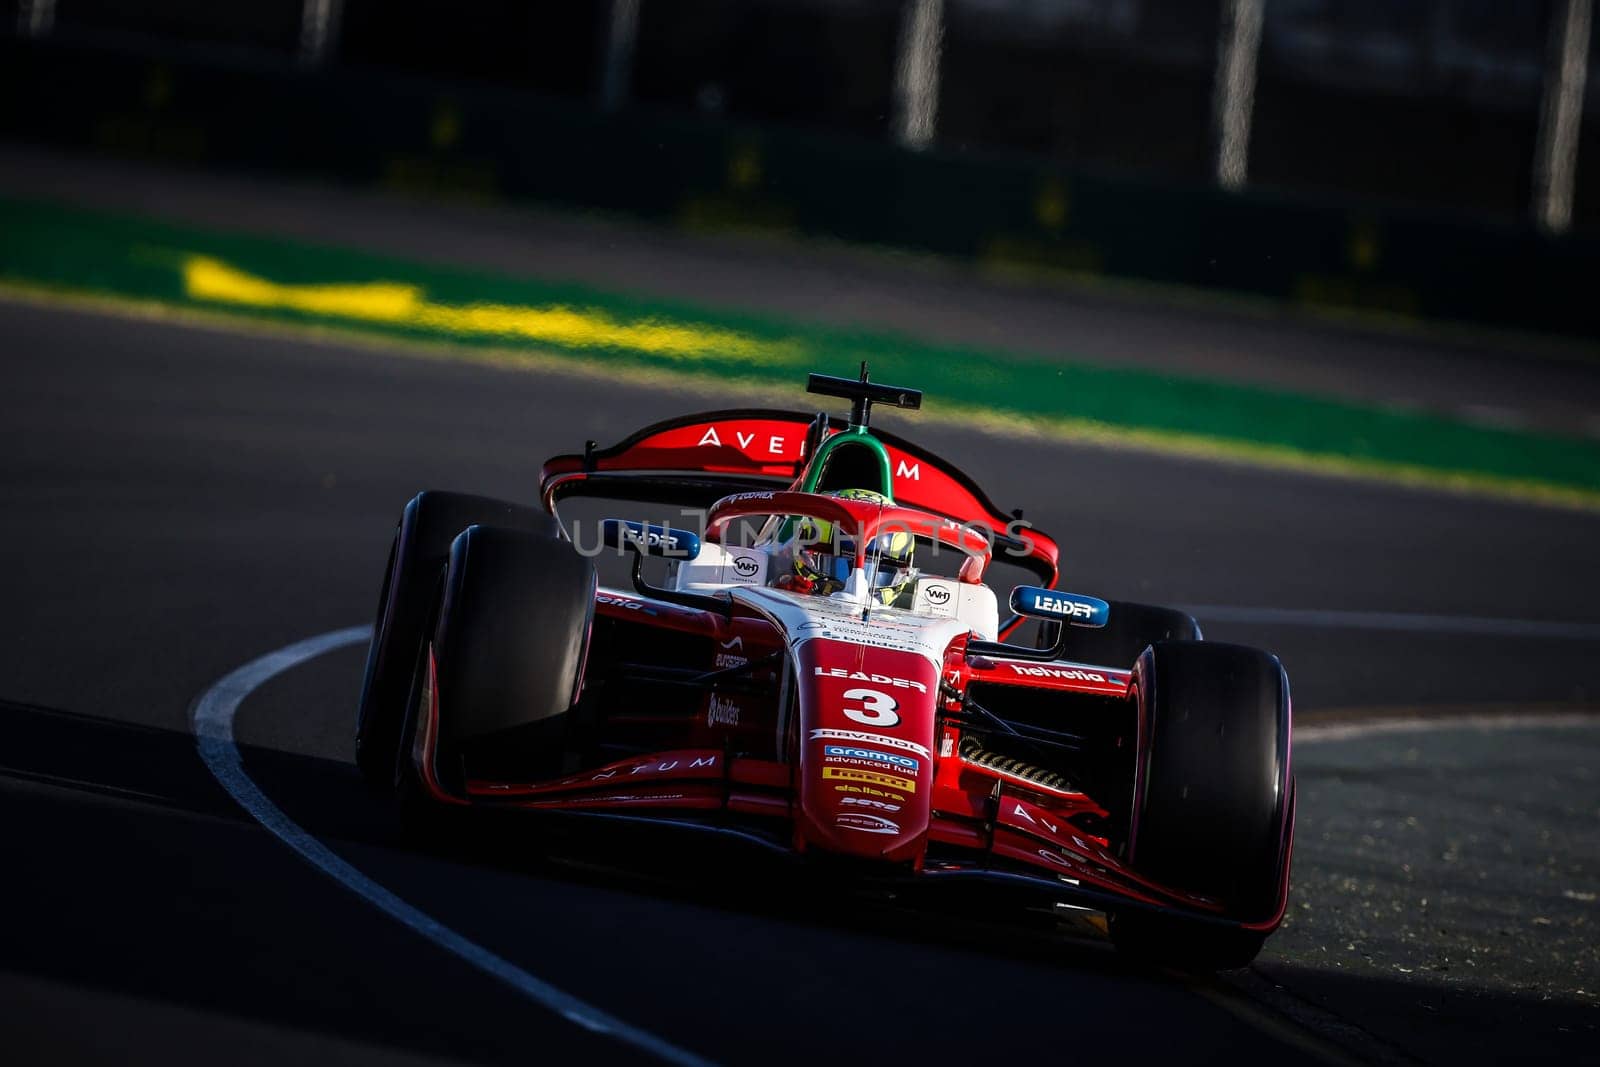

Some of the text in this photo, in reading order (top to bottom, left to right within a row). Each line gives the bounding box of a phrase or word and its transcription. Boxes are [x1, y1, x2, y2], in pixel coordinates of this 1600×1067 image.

[1034, 594, 1095, 619] LEADER
[814, 666, 926, 693] LEADER
[1010, 664, 1105, 683] helvetia
[843, 688, 899, 727] 3
[822, 730, 920, 752] RAVENOL
[825, 756, 918, 776] advanced fuel
[830, 747, 913, 766] aramco
[834, 785, 905, 801] dallara
